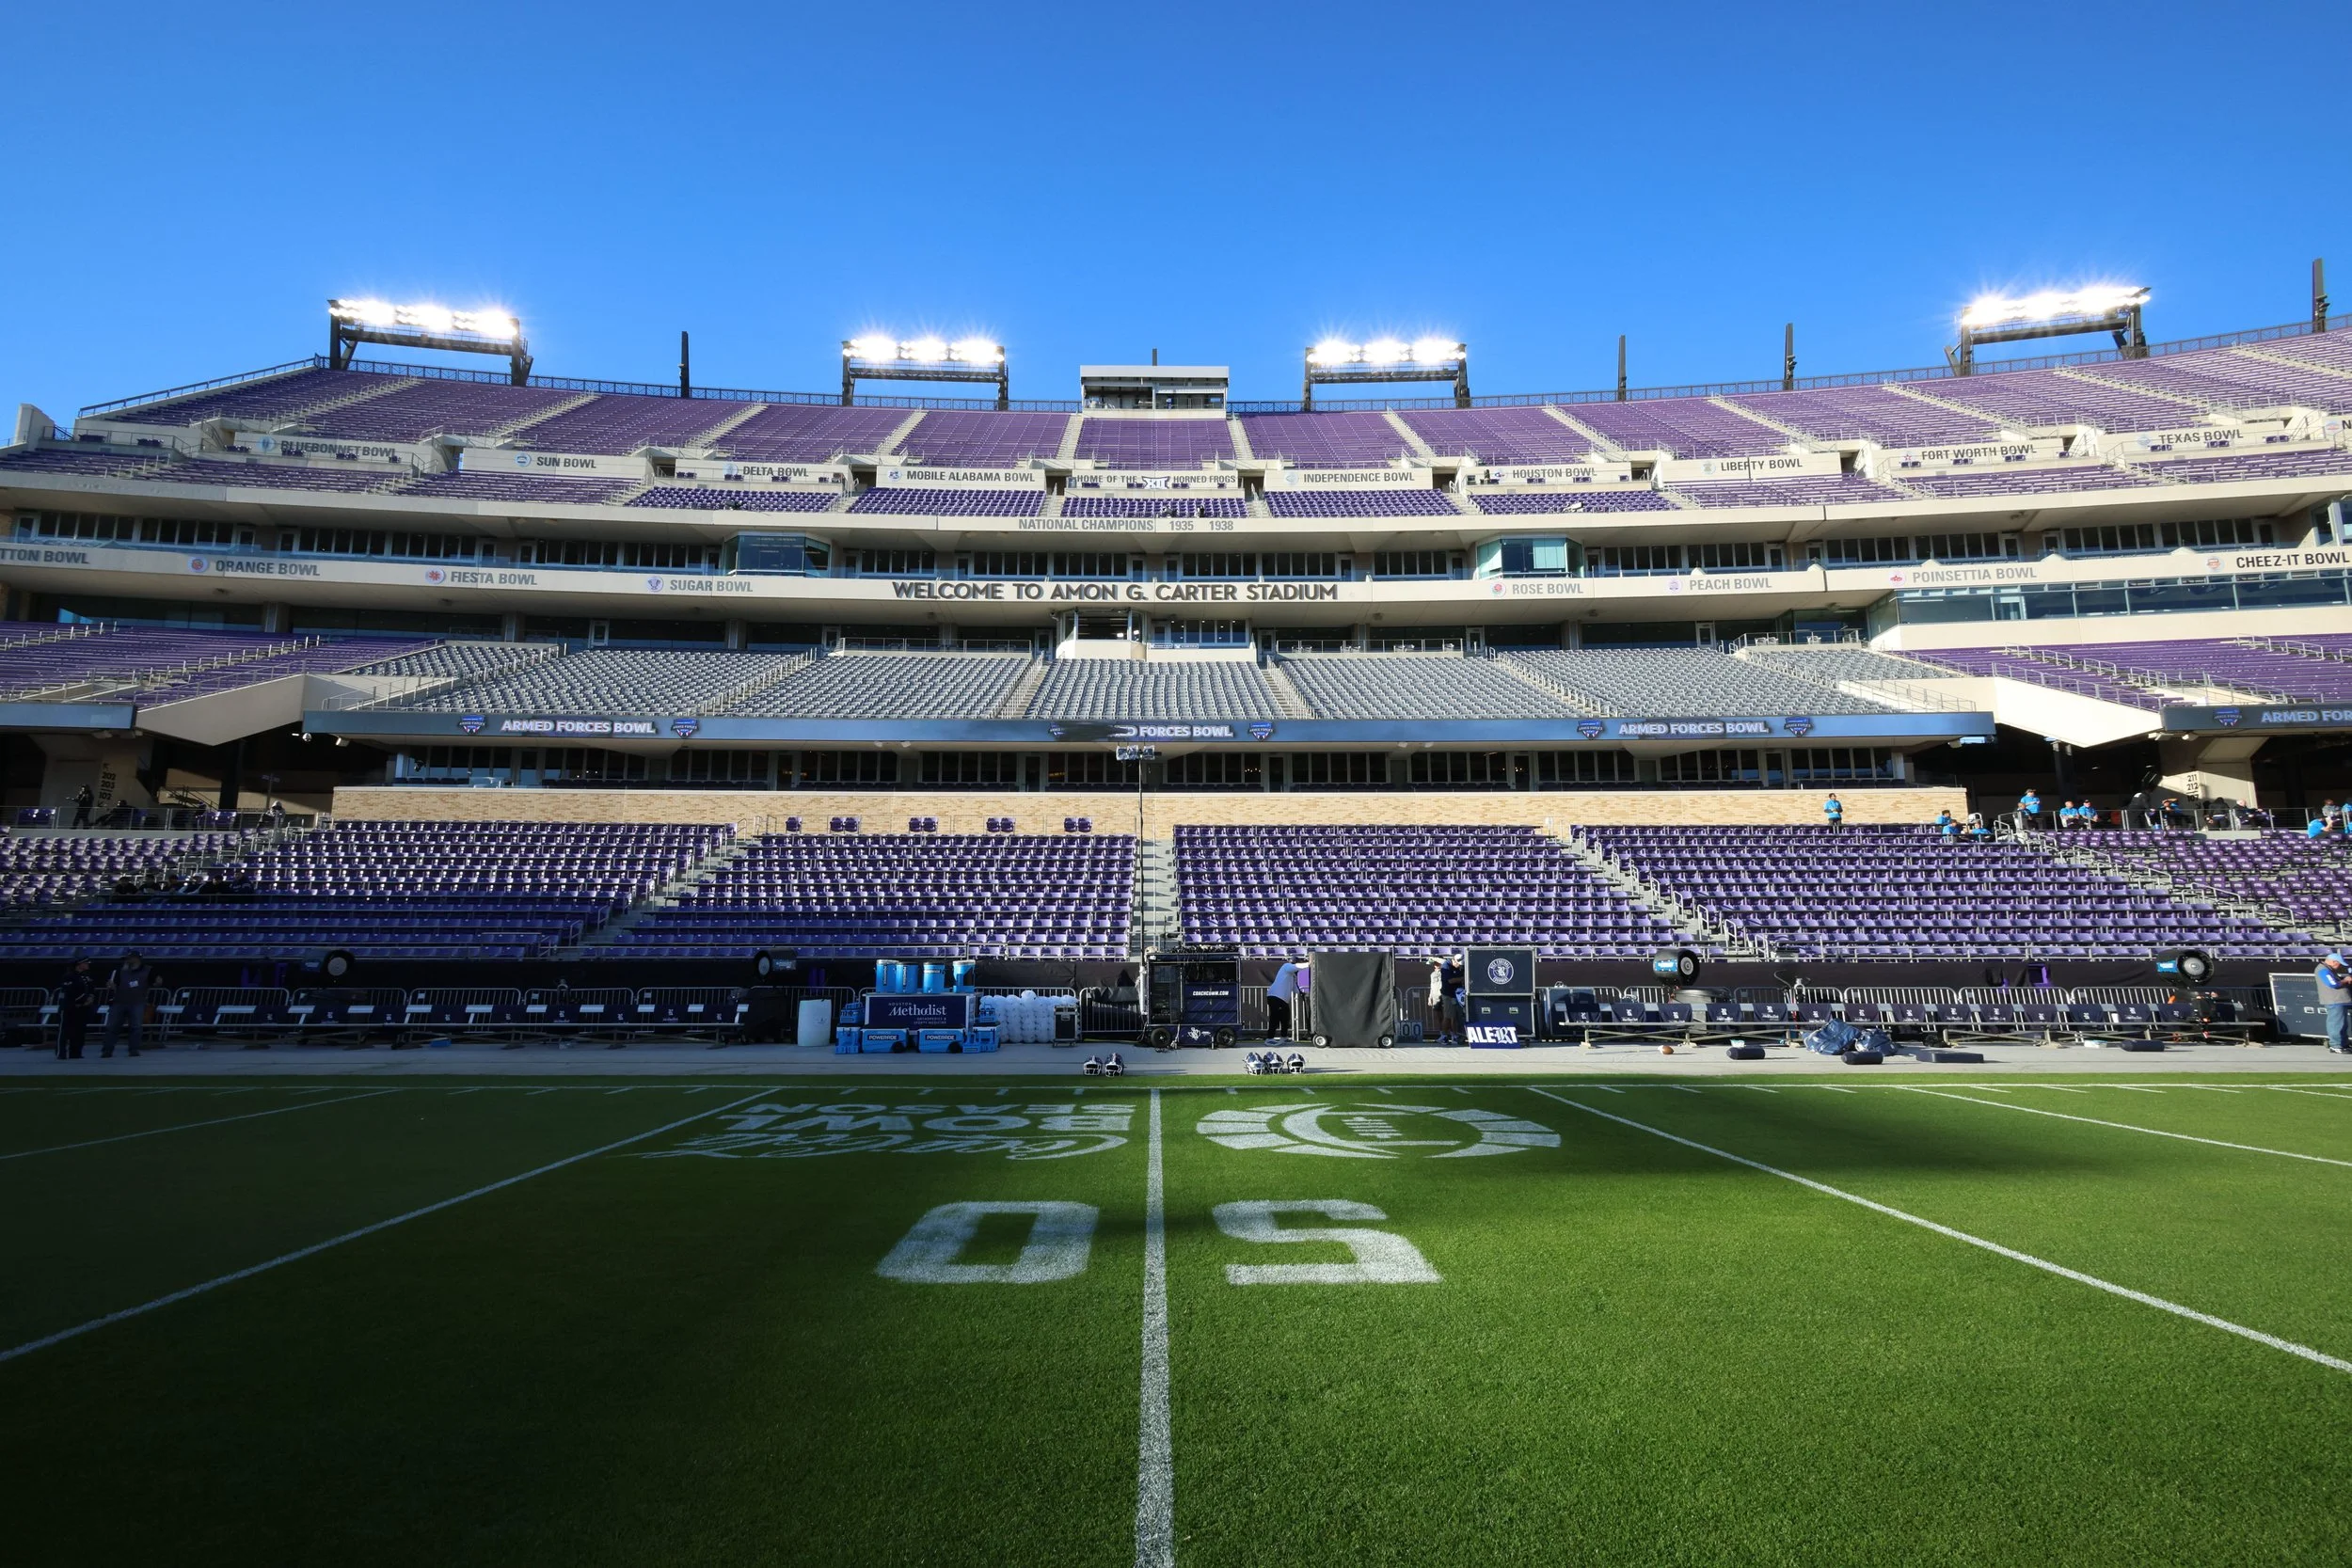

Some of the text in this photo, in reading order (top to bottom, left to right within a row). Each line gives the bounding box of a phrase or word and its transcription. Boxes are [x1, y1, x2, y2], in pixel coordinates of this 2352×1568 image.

[2158, 428, 2244, 445] TEXAS BOWL
[280, 440, 396, 458] BLUEBONNET BOWL
[1921, 444, 2038, 461] FORT WORTH BOWL
[536, 455, 596, 469] SUN BOWL
[1720, 458, 1803, 471] LIBERTY BOWL
[742, 466, 809, 477] DELTA BOWL
[906, 470, 1036, 483] MOBILE ALABAMA BOWL
[1303, 471, 1415, 483] INDEPENDENCE BOWL
[1512, 467, 1597, 479] HOUSTON BOWL
[1076, 474, 1137, 483] HOME OF THE
[1173, 475, 1236, 483] HORNED FROGS
[1018, 518, 1234, 531] NATIONAL CHAMPIONS 1935 1938
[43, 548, 89, 564] BOWL
[2236, 551, 2349, 568] CHEEZ-IT BOWL
[215, 560, 321, 577] ORANGE BOWL
[1912, 567, 2038, 583] POINSETTIA BOWL
[451, 571, 538, 586] FIESTA BOWL
[1690, 578, 1772, 591] PEACH BOWL
[669, 579, 754, 593] SUGAR BOWL
[892, 581, 1339, 601] WELCOME TO AMON G. CARTER STADIUM
[1511, 583, 1584, 595] ROSE BOWL
[2261, 710, 2321, 723] ARMED
[501, 720, 658, 735] ARMED FORCES BOWL
[1138, 725, 1191, 737] FORCES
[1192, 725, 1233, 738] BOWL
[1618, 720, 1771, 736] ARMED FORCES BOWL
[102, 771, 117, 781] 202
[2186, 774, 2198, 783] 211
[2186, 783, 2199, 791] 212
[99, 791, 112, 800] 102
[2186, 794, 2200, 802] 107
[888, 1004, 947, 1016] Methodist
[1466, 1025, 1518, 1044] ALERT
[739, 1103, 1137, 1115] SEASON
[716, 1115, 1136, 1131] BOWL
